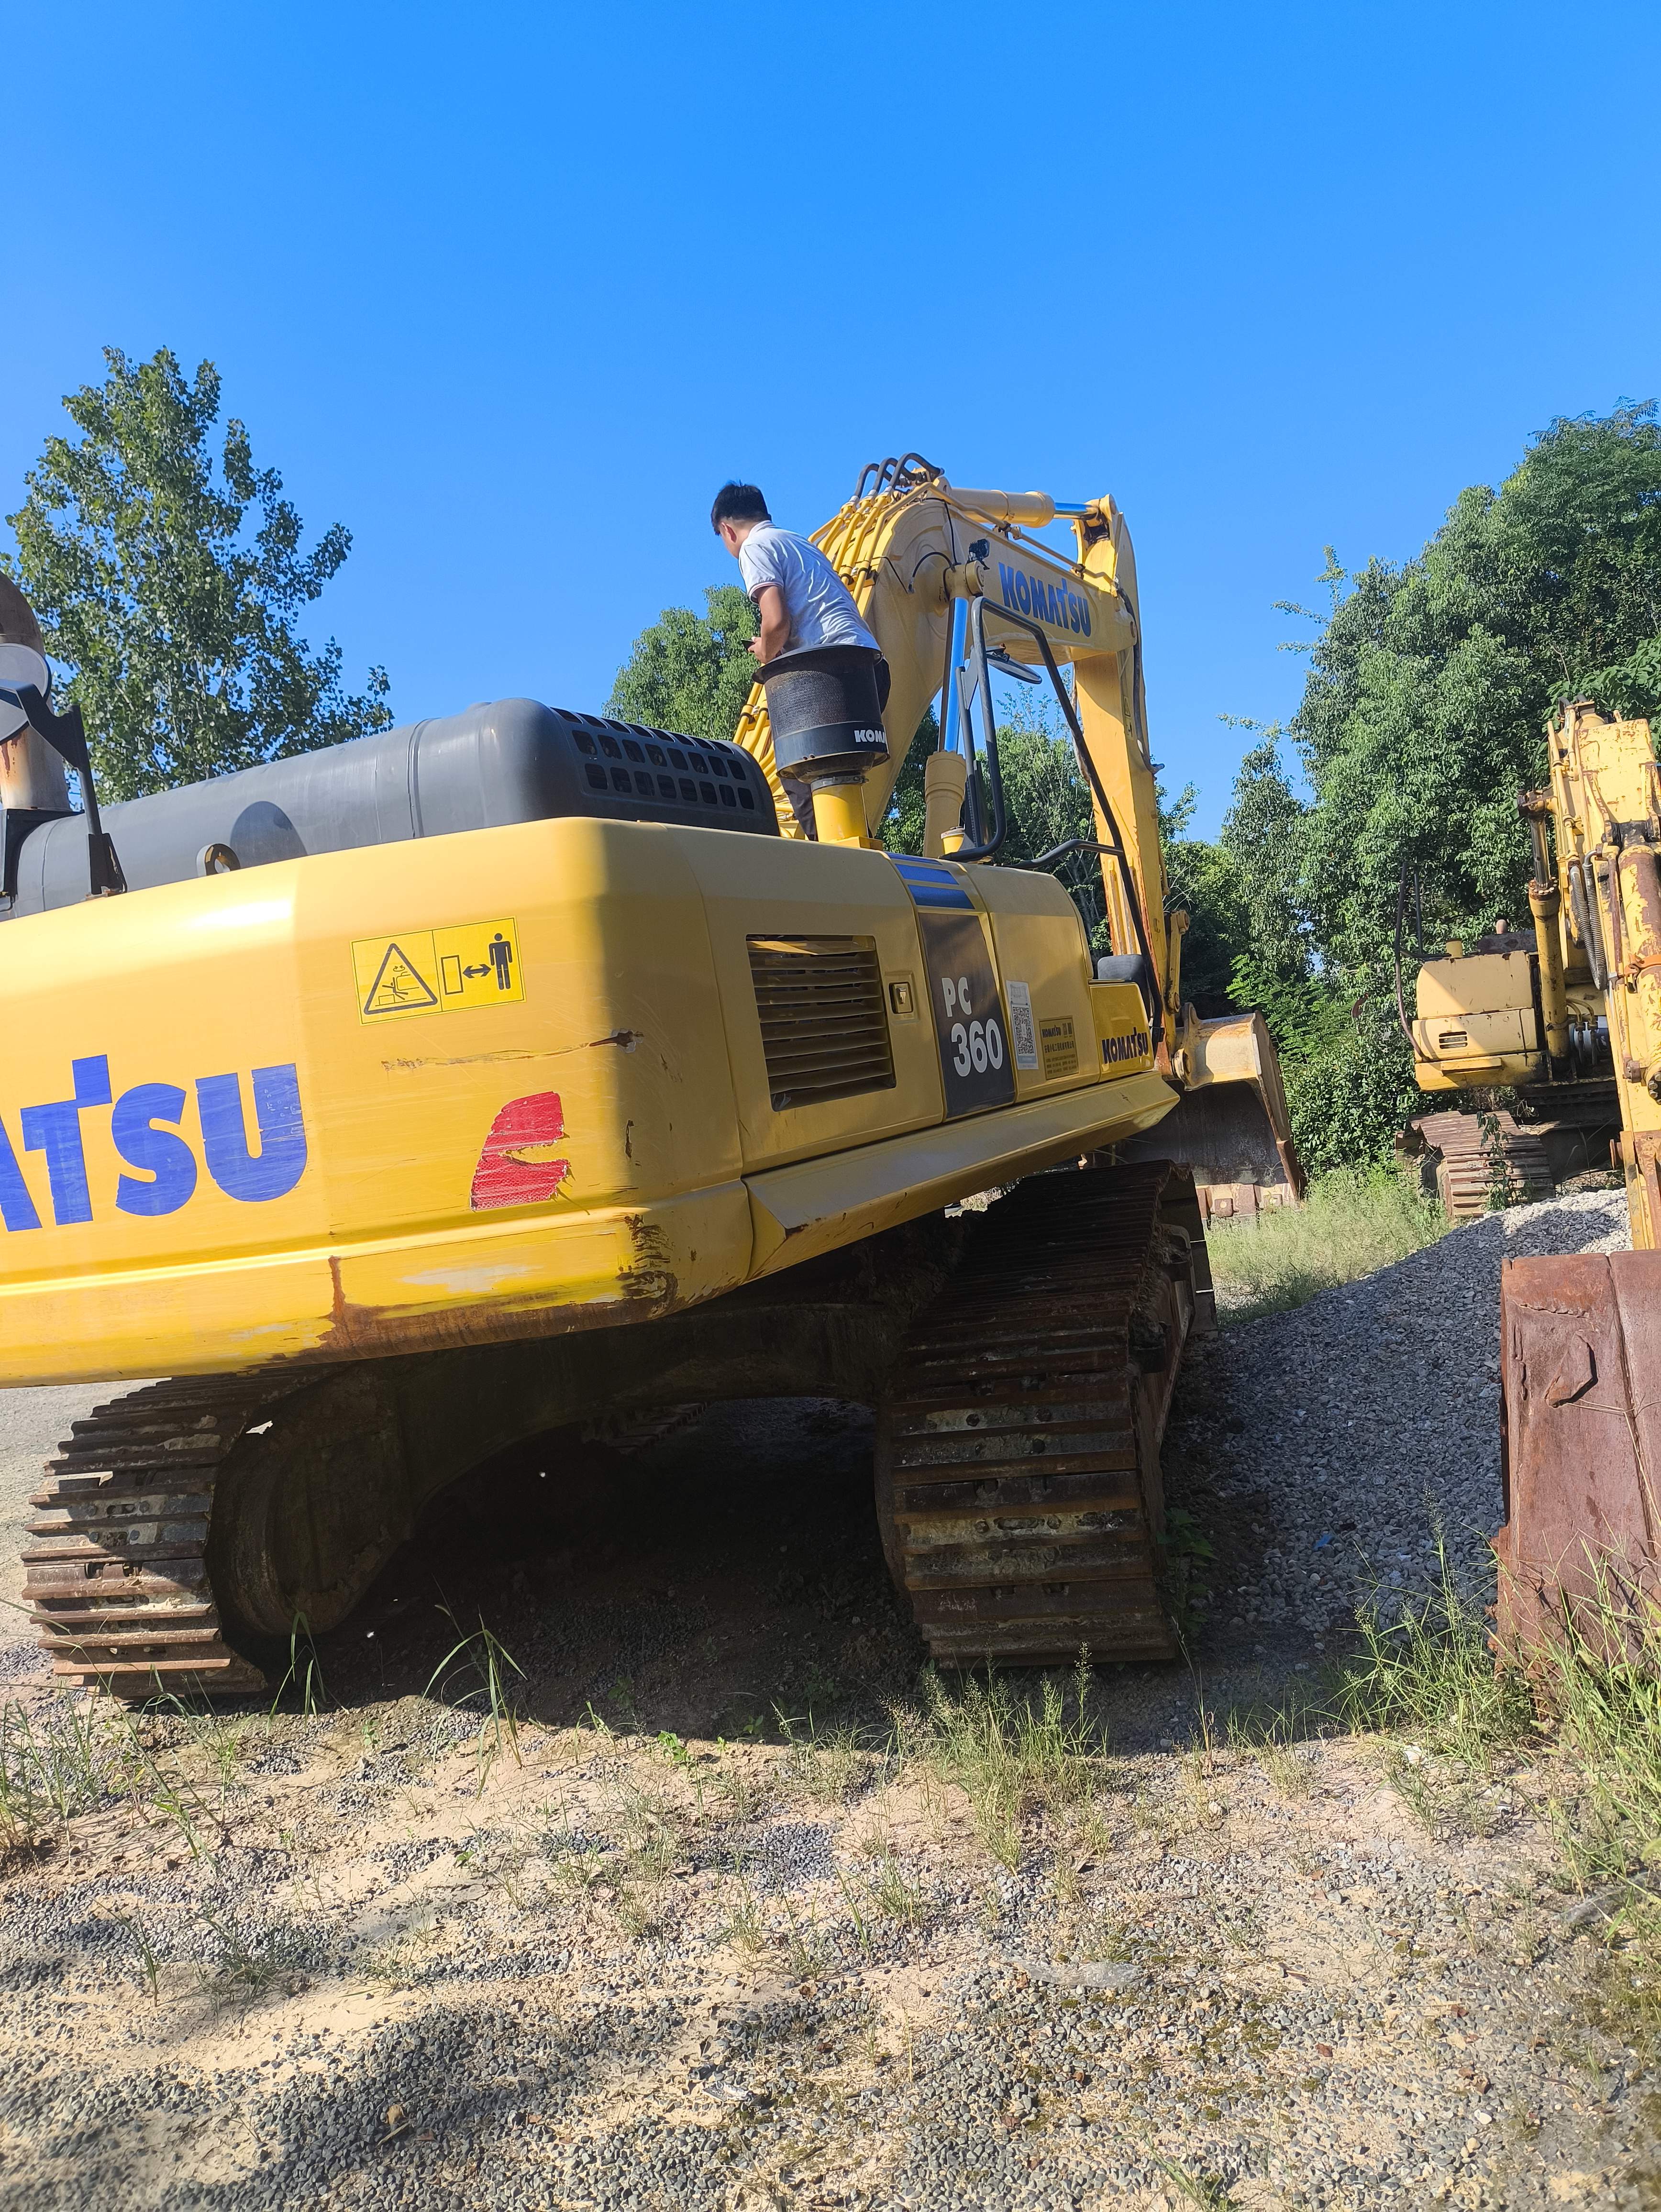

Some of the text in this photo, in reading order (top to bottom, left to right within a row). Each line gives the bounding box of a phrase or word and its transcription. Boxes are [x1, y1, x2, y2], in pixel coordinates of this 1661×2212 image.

[998, 562, 1091, 637] KOMATSU
[941, 977, 972, 1017] PC
[951, 1018, 1003, 1077] 360
[1042, 1025, 1061, 1038] KOMATSU
[1102, 1027, 1149, 1064] KOMATSU
